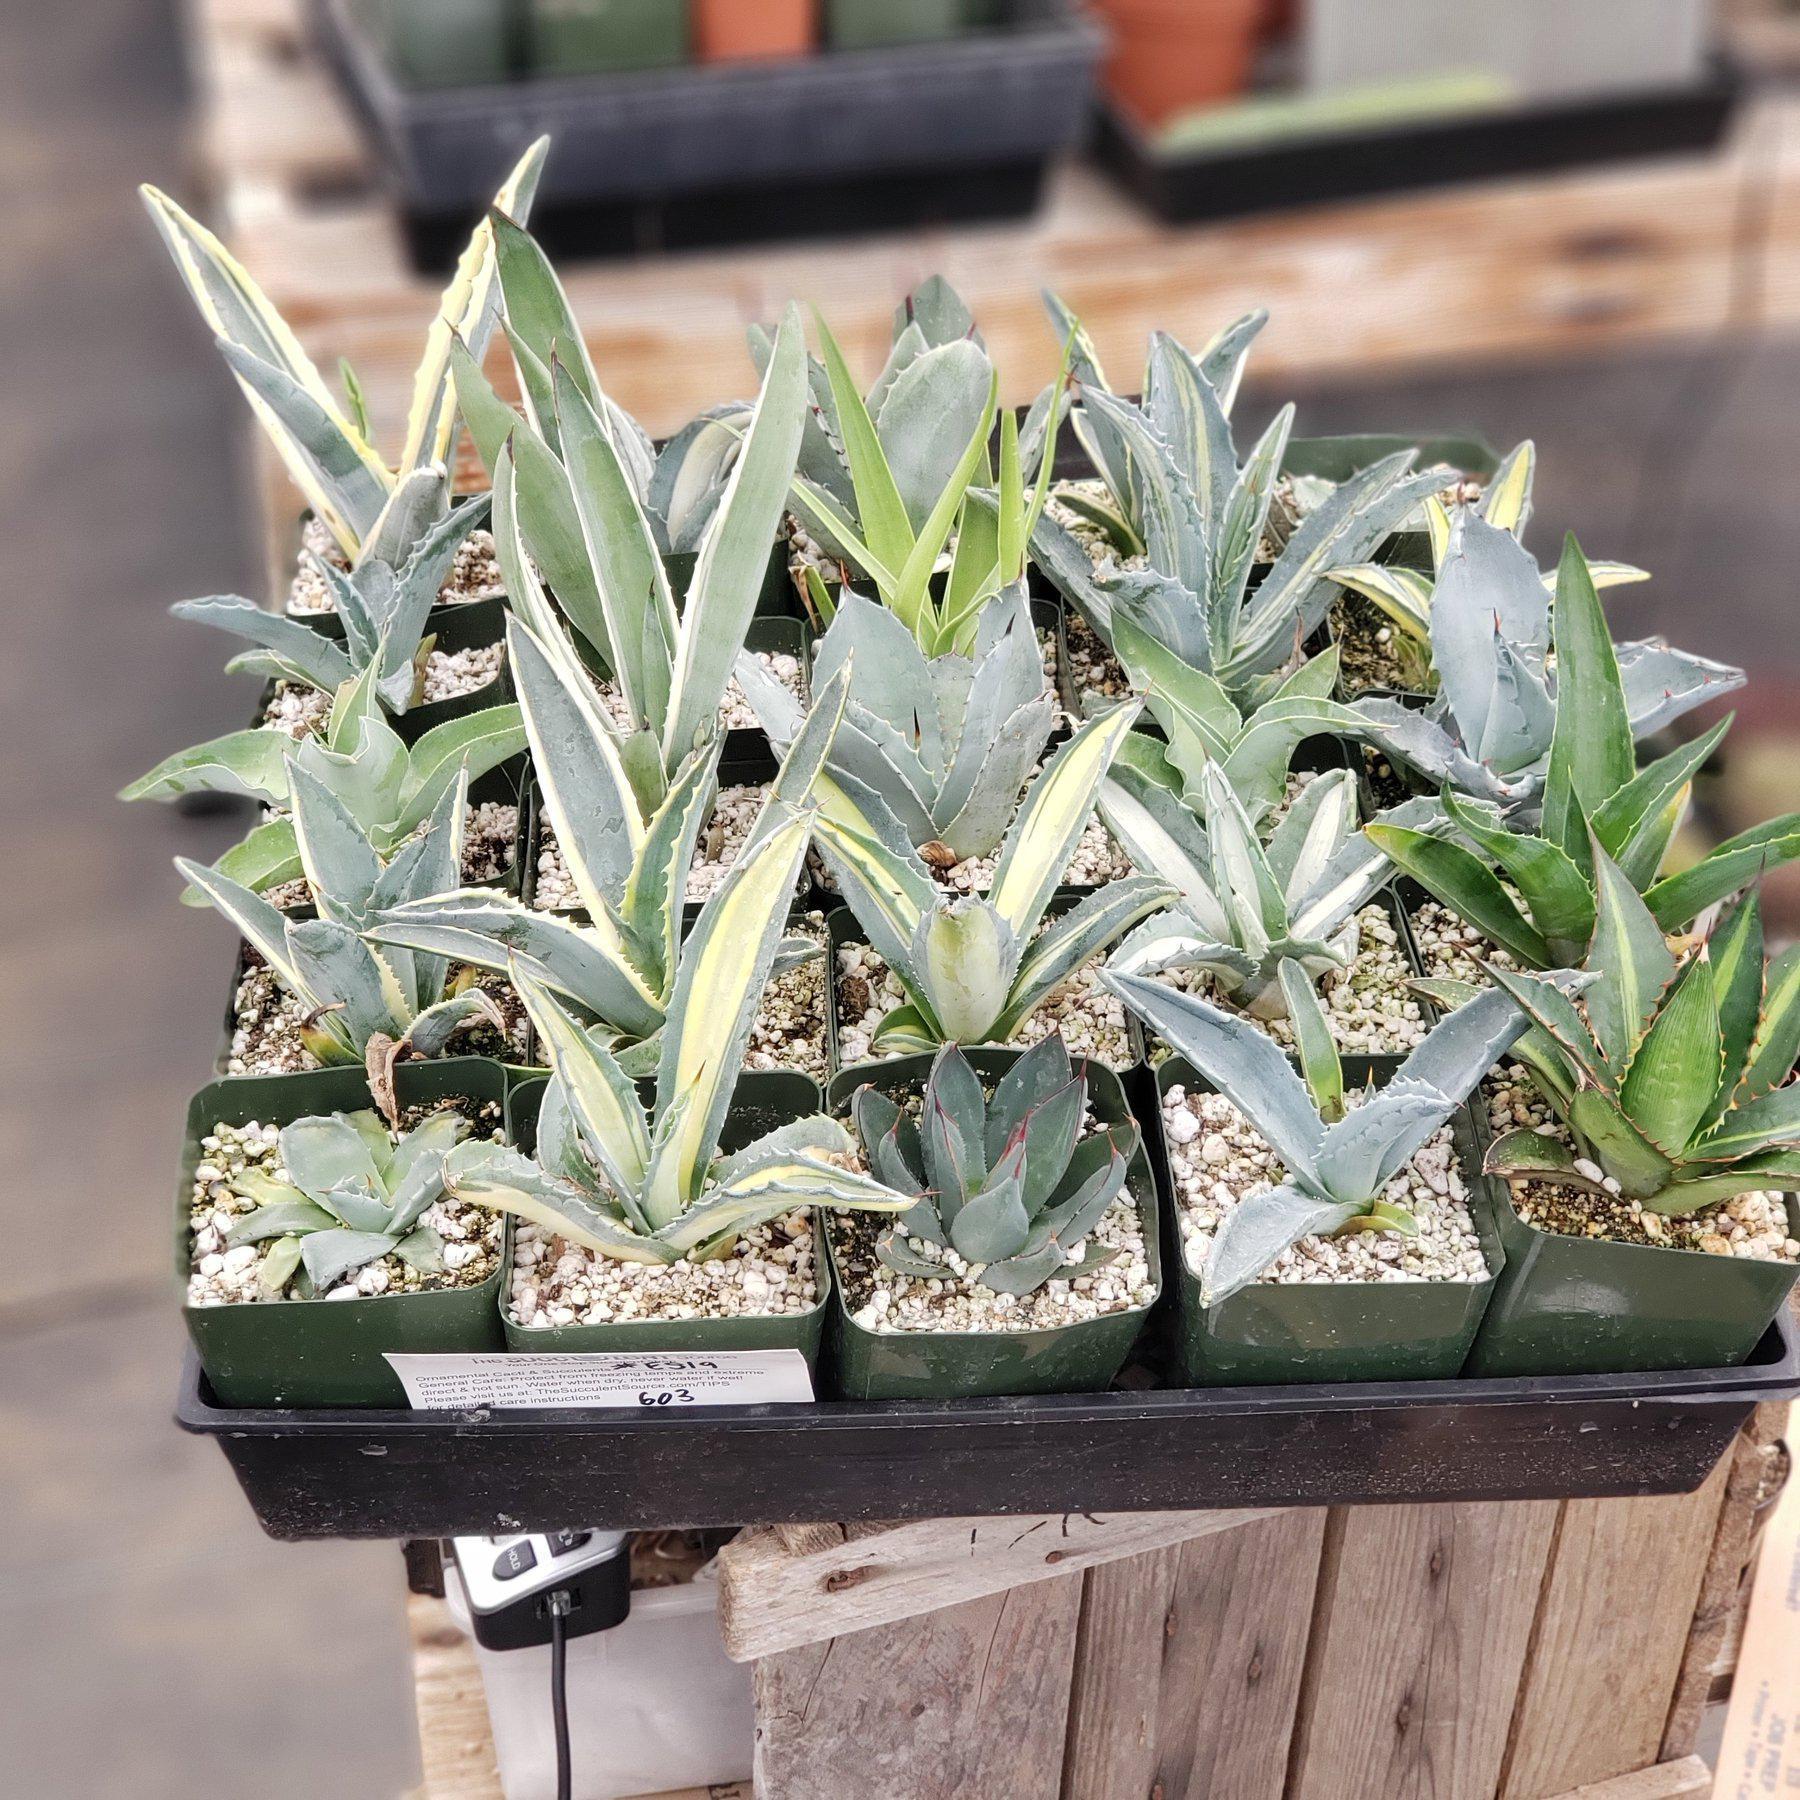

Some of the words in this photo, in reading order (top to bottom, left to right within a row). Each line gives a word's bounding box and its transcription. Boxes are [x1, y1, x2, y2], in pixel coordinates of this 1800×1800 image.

[415, 1372, 489, 1382] Ornamental
[418, 1380, 468, 1388] General
[591, 1370, 640, 1378] freezing
[421, 1388, 456, 1396] direct
[424, 1395, 467, 1403] Please
[537, 1381, 731, 1395] TheSucculentSource.com/TIPS
[638, 1388, 695, 1405] 603
[447, 1400, 496, 1409] detaild
[530, 1394, 601, 1404] instructions
[505, 1547, 521, 1570] HOLD
